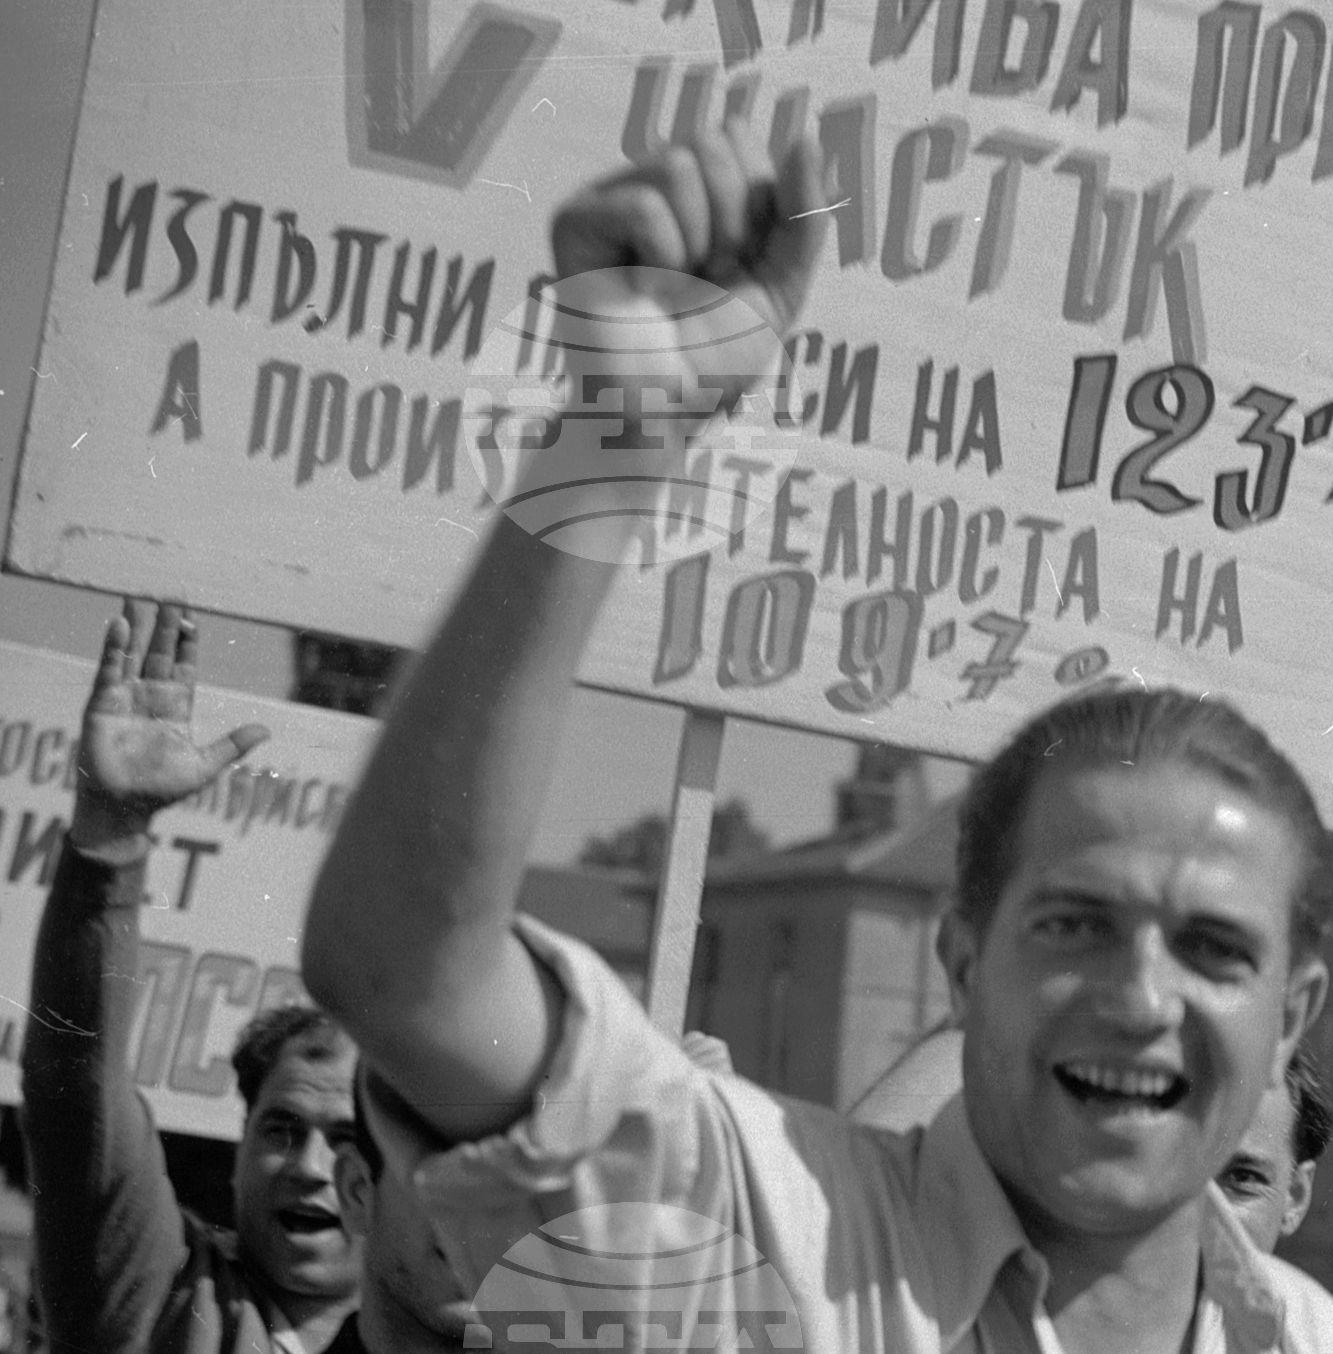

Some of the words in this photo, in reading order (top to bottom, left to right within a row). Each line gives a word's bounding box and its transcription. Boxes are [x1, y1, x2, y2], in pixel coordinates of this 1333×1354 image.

[344, 0, 563, 192] V
[93, 173, 497, 364] ИЗПЪЛНИ
[907, 357, 1003, 477] НА
[149, 339, 203, 444] А
[1154, 546, 1244, 657] НА
